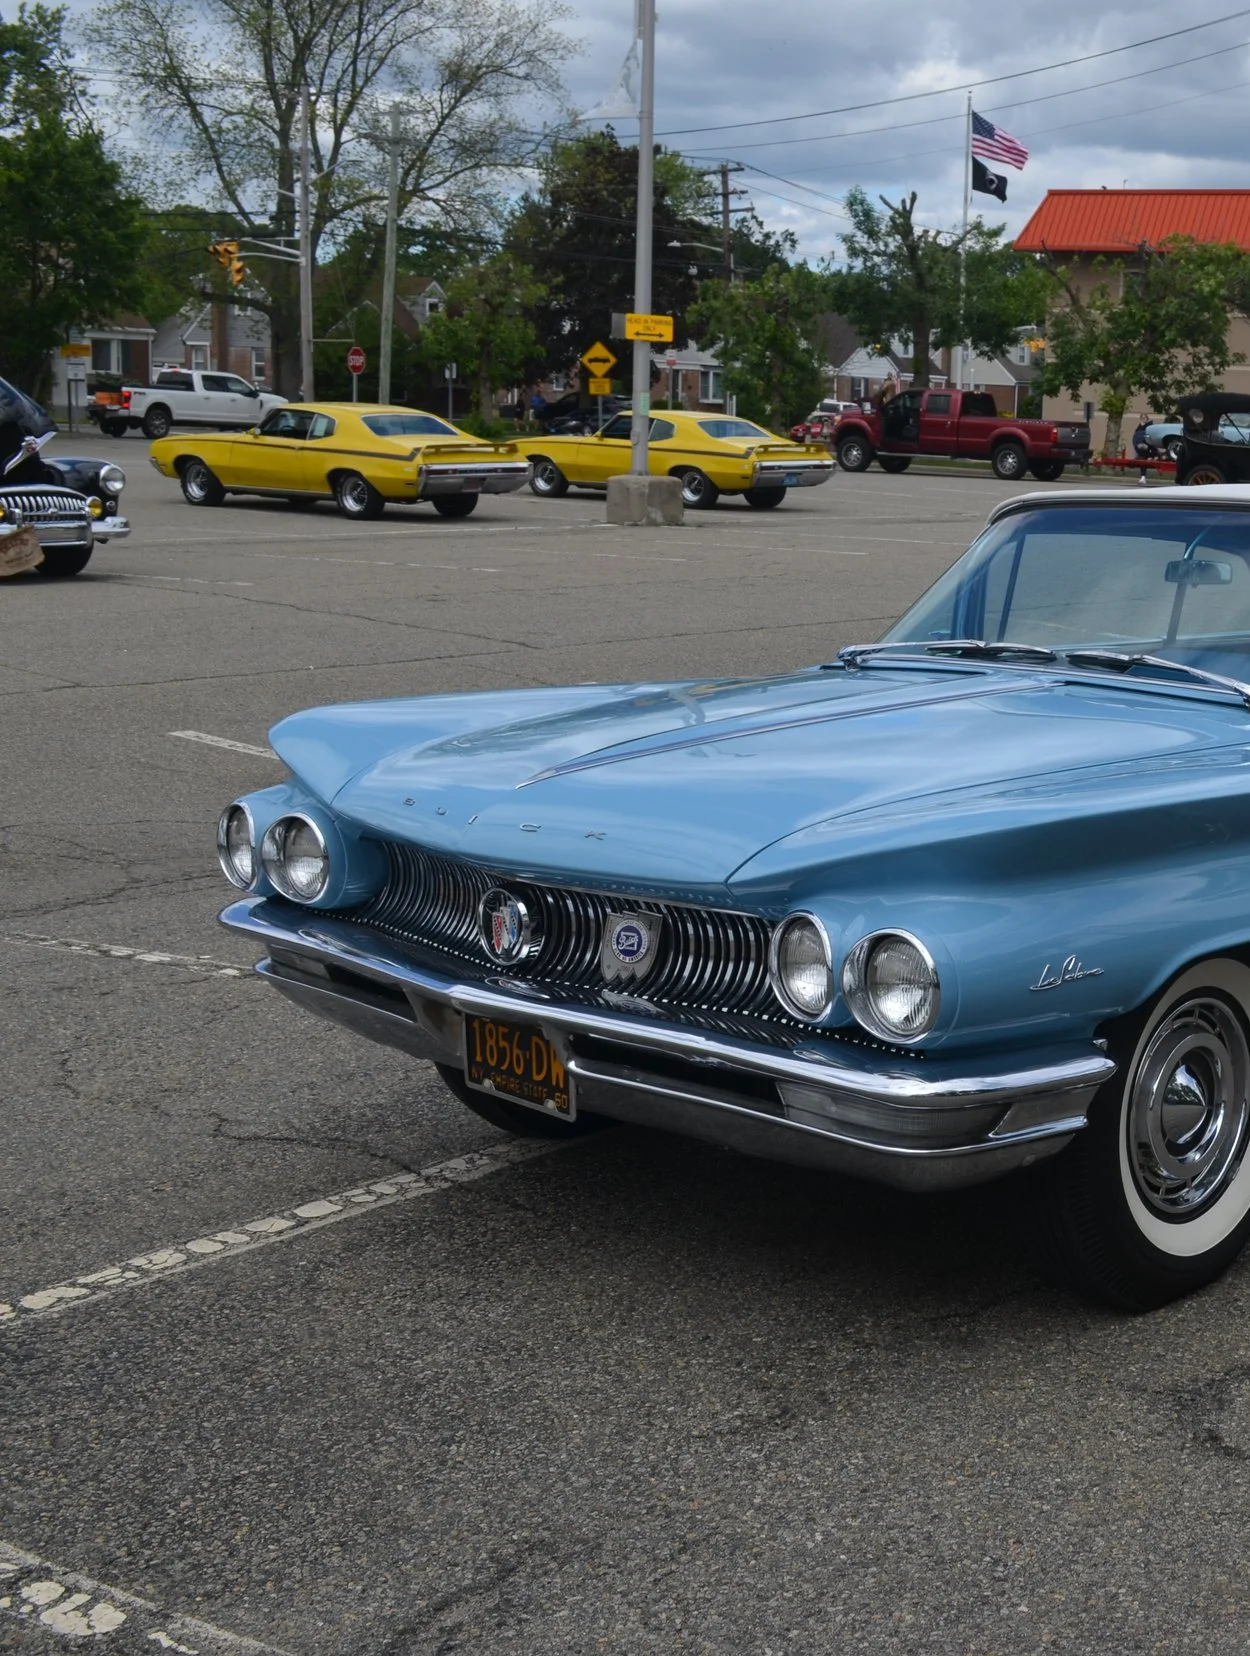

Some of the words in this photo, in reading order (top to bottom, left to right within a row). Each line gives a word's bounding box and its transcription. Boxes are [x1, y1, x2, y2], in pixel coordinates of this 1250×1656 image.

[349, 355, 364, 366] STOP
[403, 796, 608, 842] BUICK
[491, 1072, 521, 1093] EMPIRE
[523, 1082, 548, 1099] STATE
